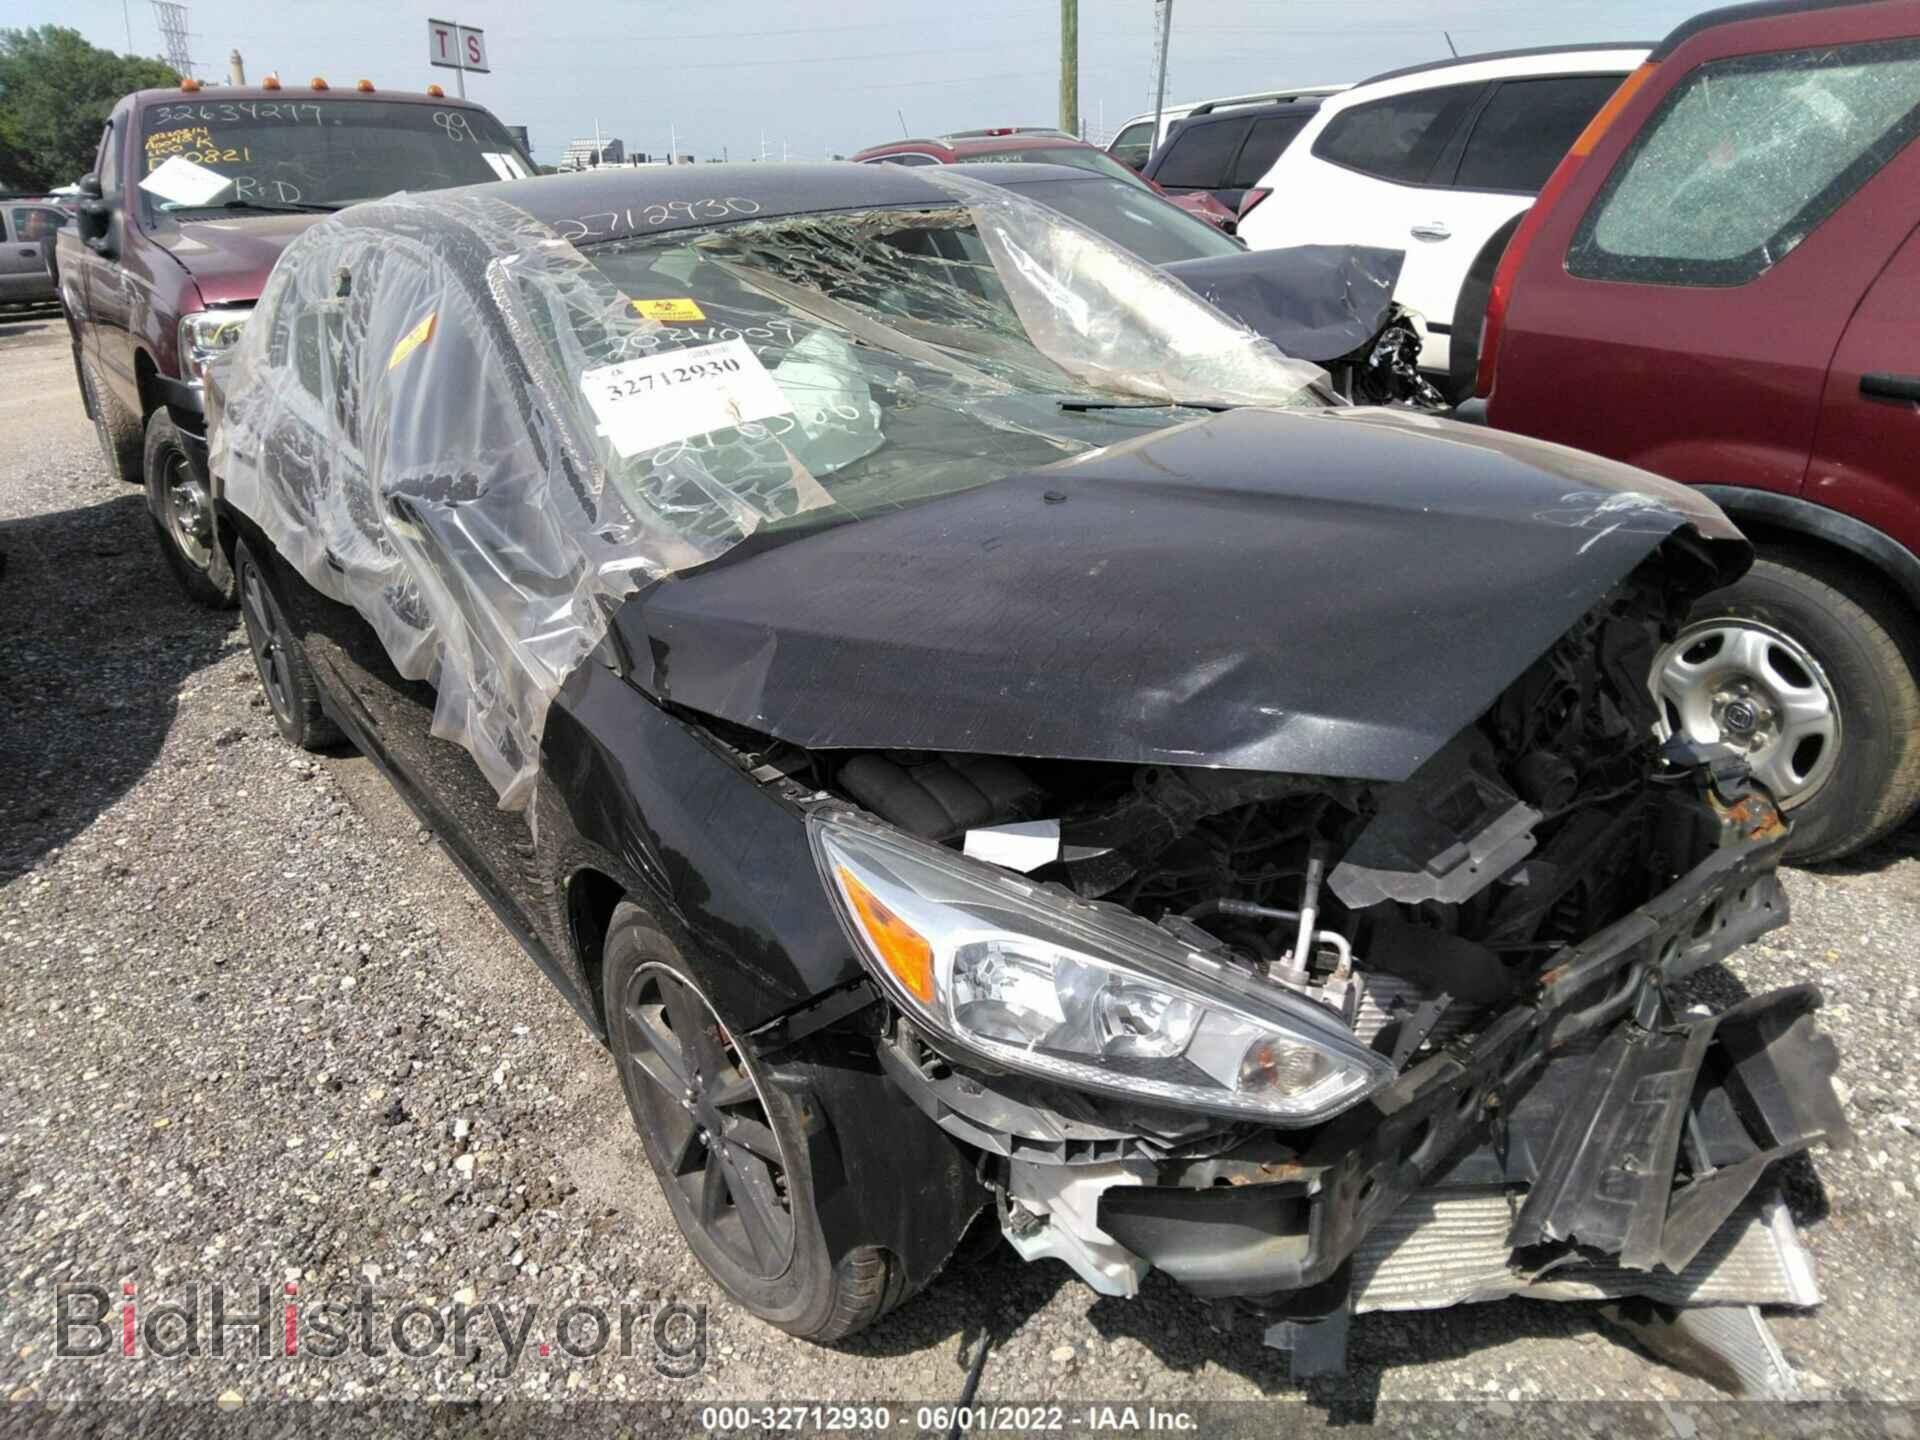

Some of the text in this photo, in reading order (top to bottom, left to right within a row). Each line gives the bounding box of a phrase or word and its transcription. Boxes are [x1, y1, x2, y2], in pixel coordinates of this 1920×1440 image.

[435, 29, 481, 63] T S
[606, 357, 741, 401] 32712930
